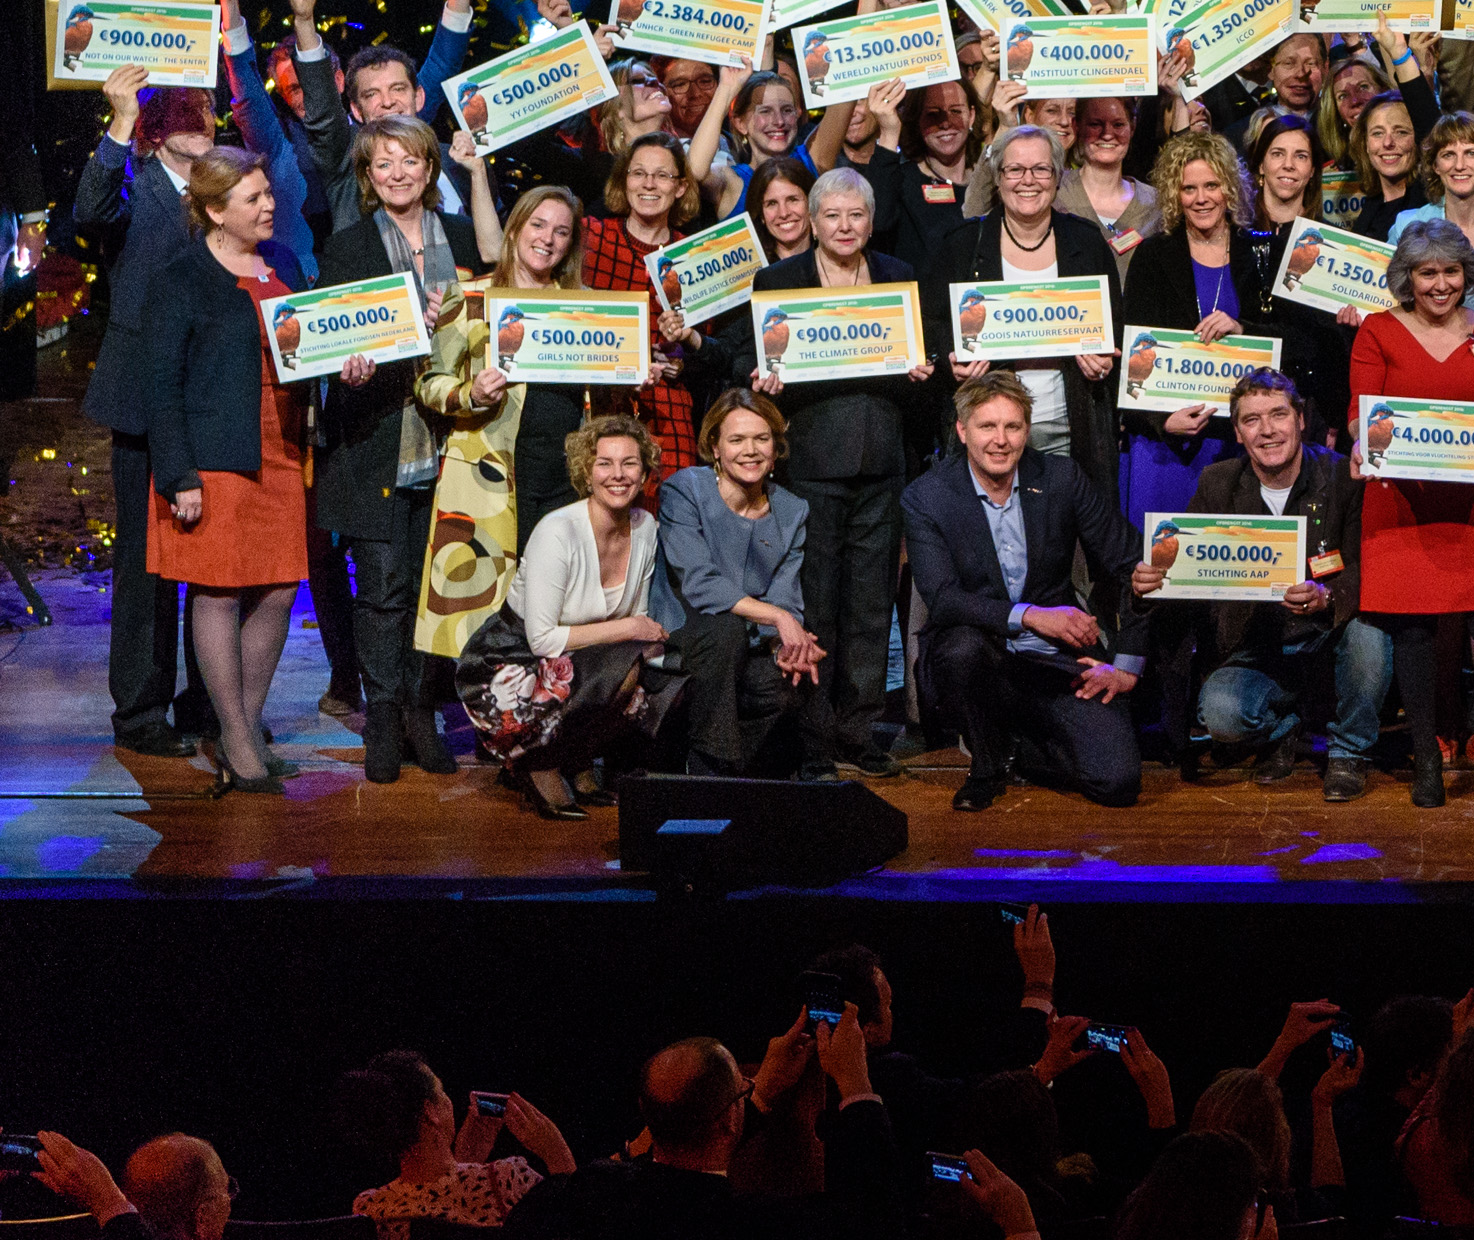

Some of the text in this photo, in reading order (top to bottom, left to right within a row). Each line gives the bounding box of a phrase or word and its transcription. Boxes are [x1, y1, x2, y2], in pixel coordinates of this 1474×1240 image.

[643, 0, 755, 36] €2.384.000,-
[99, 28, 197, 54] €900.000,-
[823, 33, 944, 64] €13.500.000,-
[1040, 45, 1135, 62] €400.000,-
[832, 60, 910, 81] WERELD NATUUR
[1080, 66, 1145, 77] CLINGENDAEL
[492, 62, 582, 106] €500.000,-
[522, 83, 581, 116] FOUNDATION
[678, 247, 753, 286] €2.500.000,-
[1330, 283, 1393, 308] SOLIDARIDAD
[307, 306, 399, 334] €500.000,-
[993, 305, 1088, 324] €900.000,-
[531, 328, 625, 350] €500.000,-
[796, 322, 892, 344] €900.000,-
[1013, 326, 1104, 340] NATUURRESERVAAT
[537, 353, 620, 364] GIRLS BRIDES
[819, 345, 894, 359] CLIMATE GROUP
[1155, 381, 1196, 393] CLINTON
[1185, 544, 1283, 565] €500.000,-
[1197, 568, 1270, 579] STICHTING AAP
